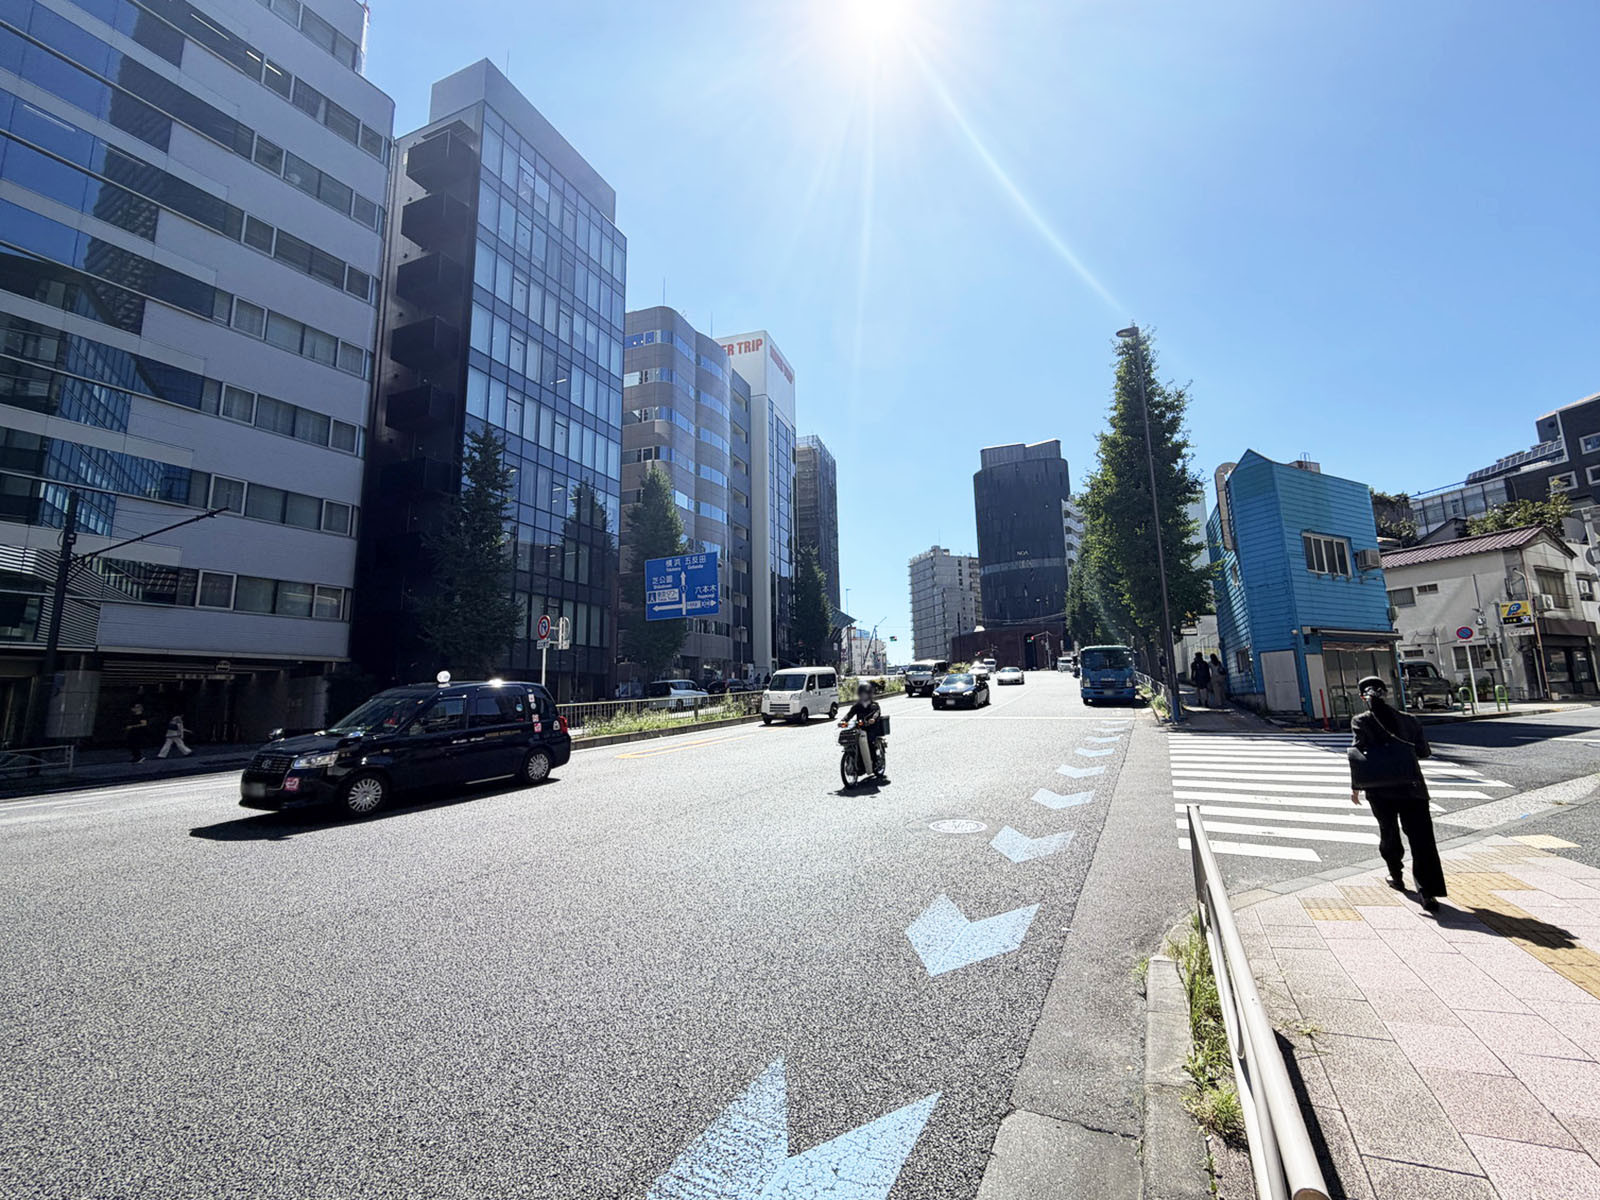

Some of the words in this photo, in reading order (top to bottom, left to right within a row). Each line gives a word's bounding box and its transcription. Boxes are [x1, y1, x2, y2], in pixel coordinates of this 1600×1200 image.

[736, 338, 763, 354] TRIP
[685, 555, 706, 565] 五反田
[695, 585, 717, 594] 六本木
